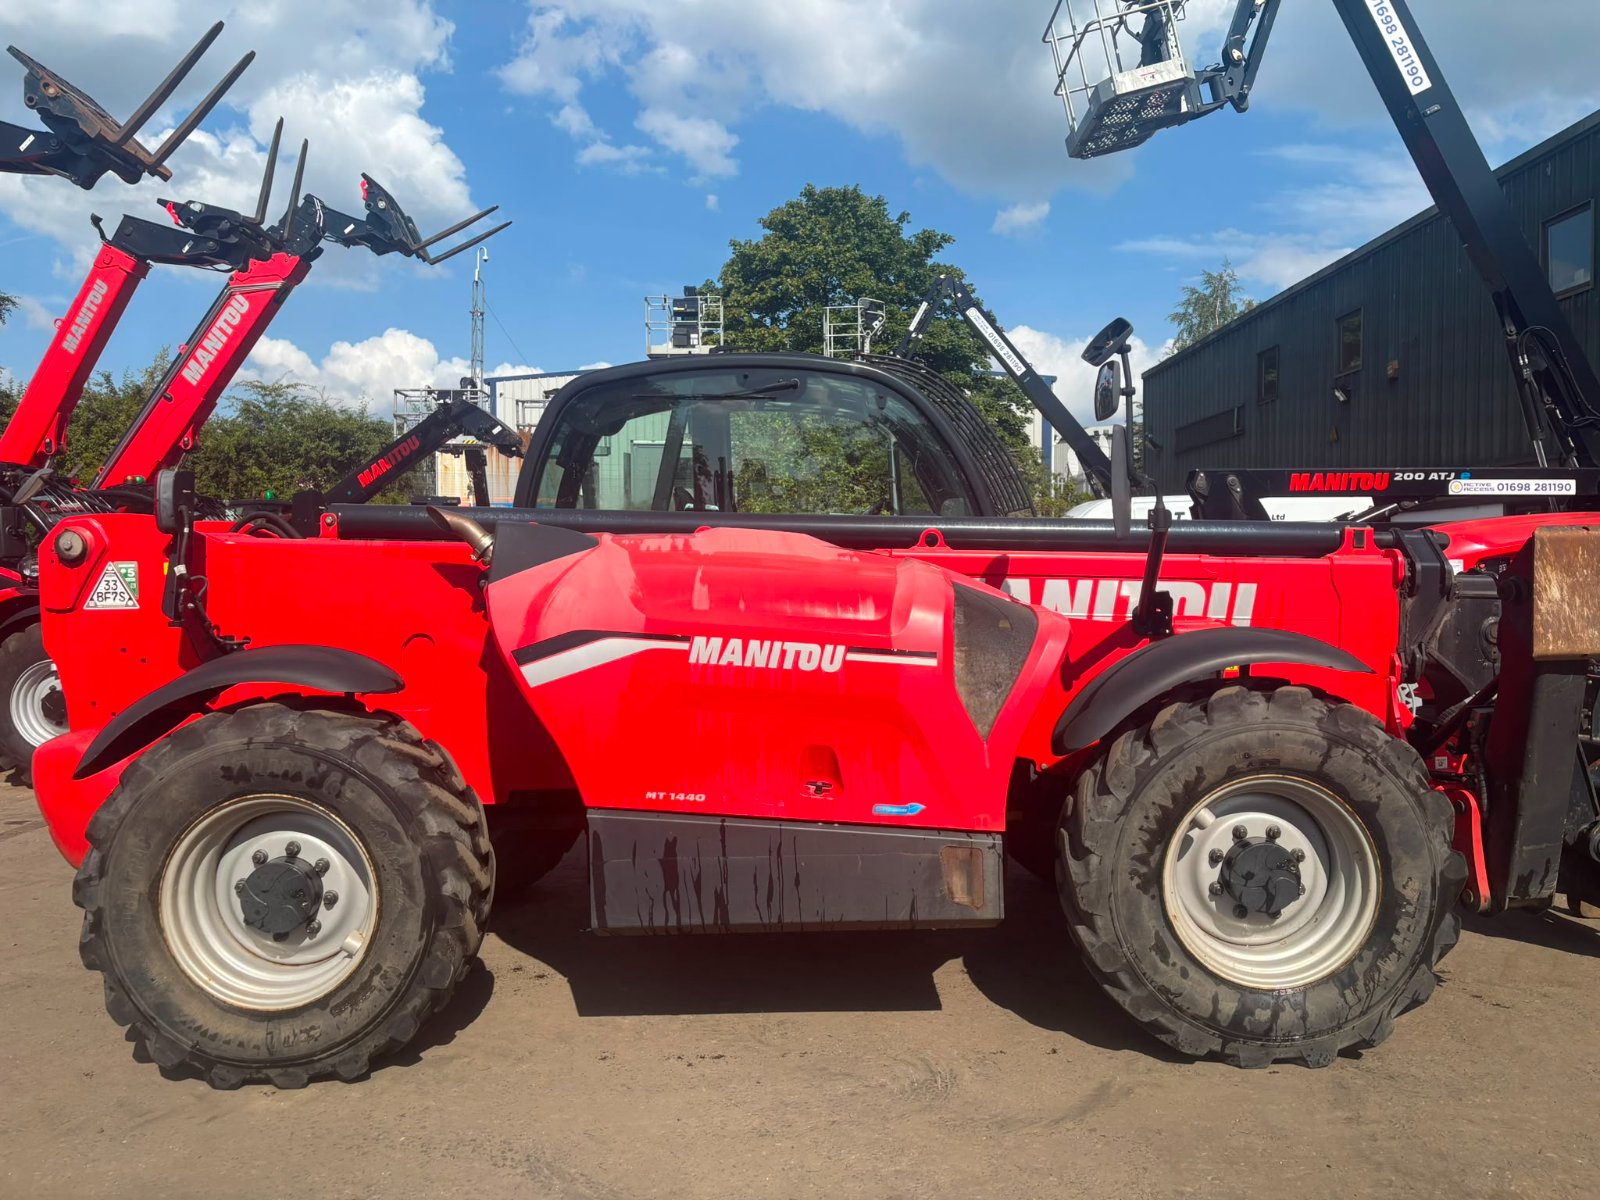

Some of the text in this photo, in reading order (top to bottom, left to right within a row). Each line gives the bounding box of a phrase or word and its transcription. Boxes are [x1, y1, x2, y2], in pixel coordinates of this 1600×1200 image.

[1371, 0, 1424, 87] 1698 281190
[62, 279, 109, 355] MANITOU
[181, 293, 250, 387] MANITOU
[987, 331, 1023, 373] 01698 281190
[356, 434, 421, 489] MANITOU
[1289, 472, 1390, 491] MANITOU
[1393, 472, 1423, 481] 200
[1428, 472, 1456, 481] ATJ
[1496, 482, 1572, 492] 01698 281190
[1271, 513, 1286, 521] Ltd
[127, 568, 136, 578] 5
[103, 579, 118, 591] 33
[96, 591, 126, 603] BF7S
[688, 635, 846, 673] MANITOU
[645, 791, 706, 802] MT 1440
